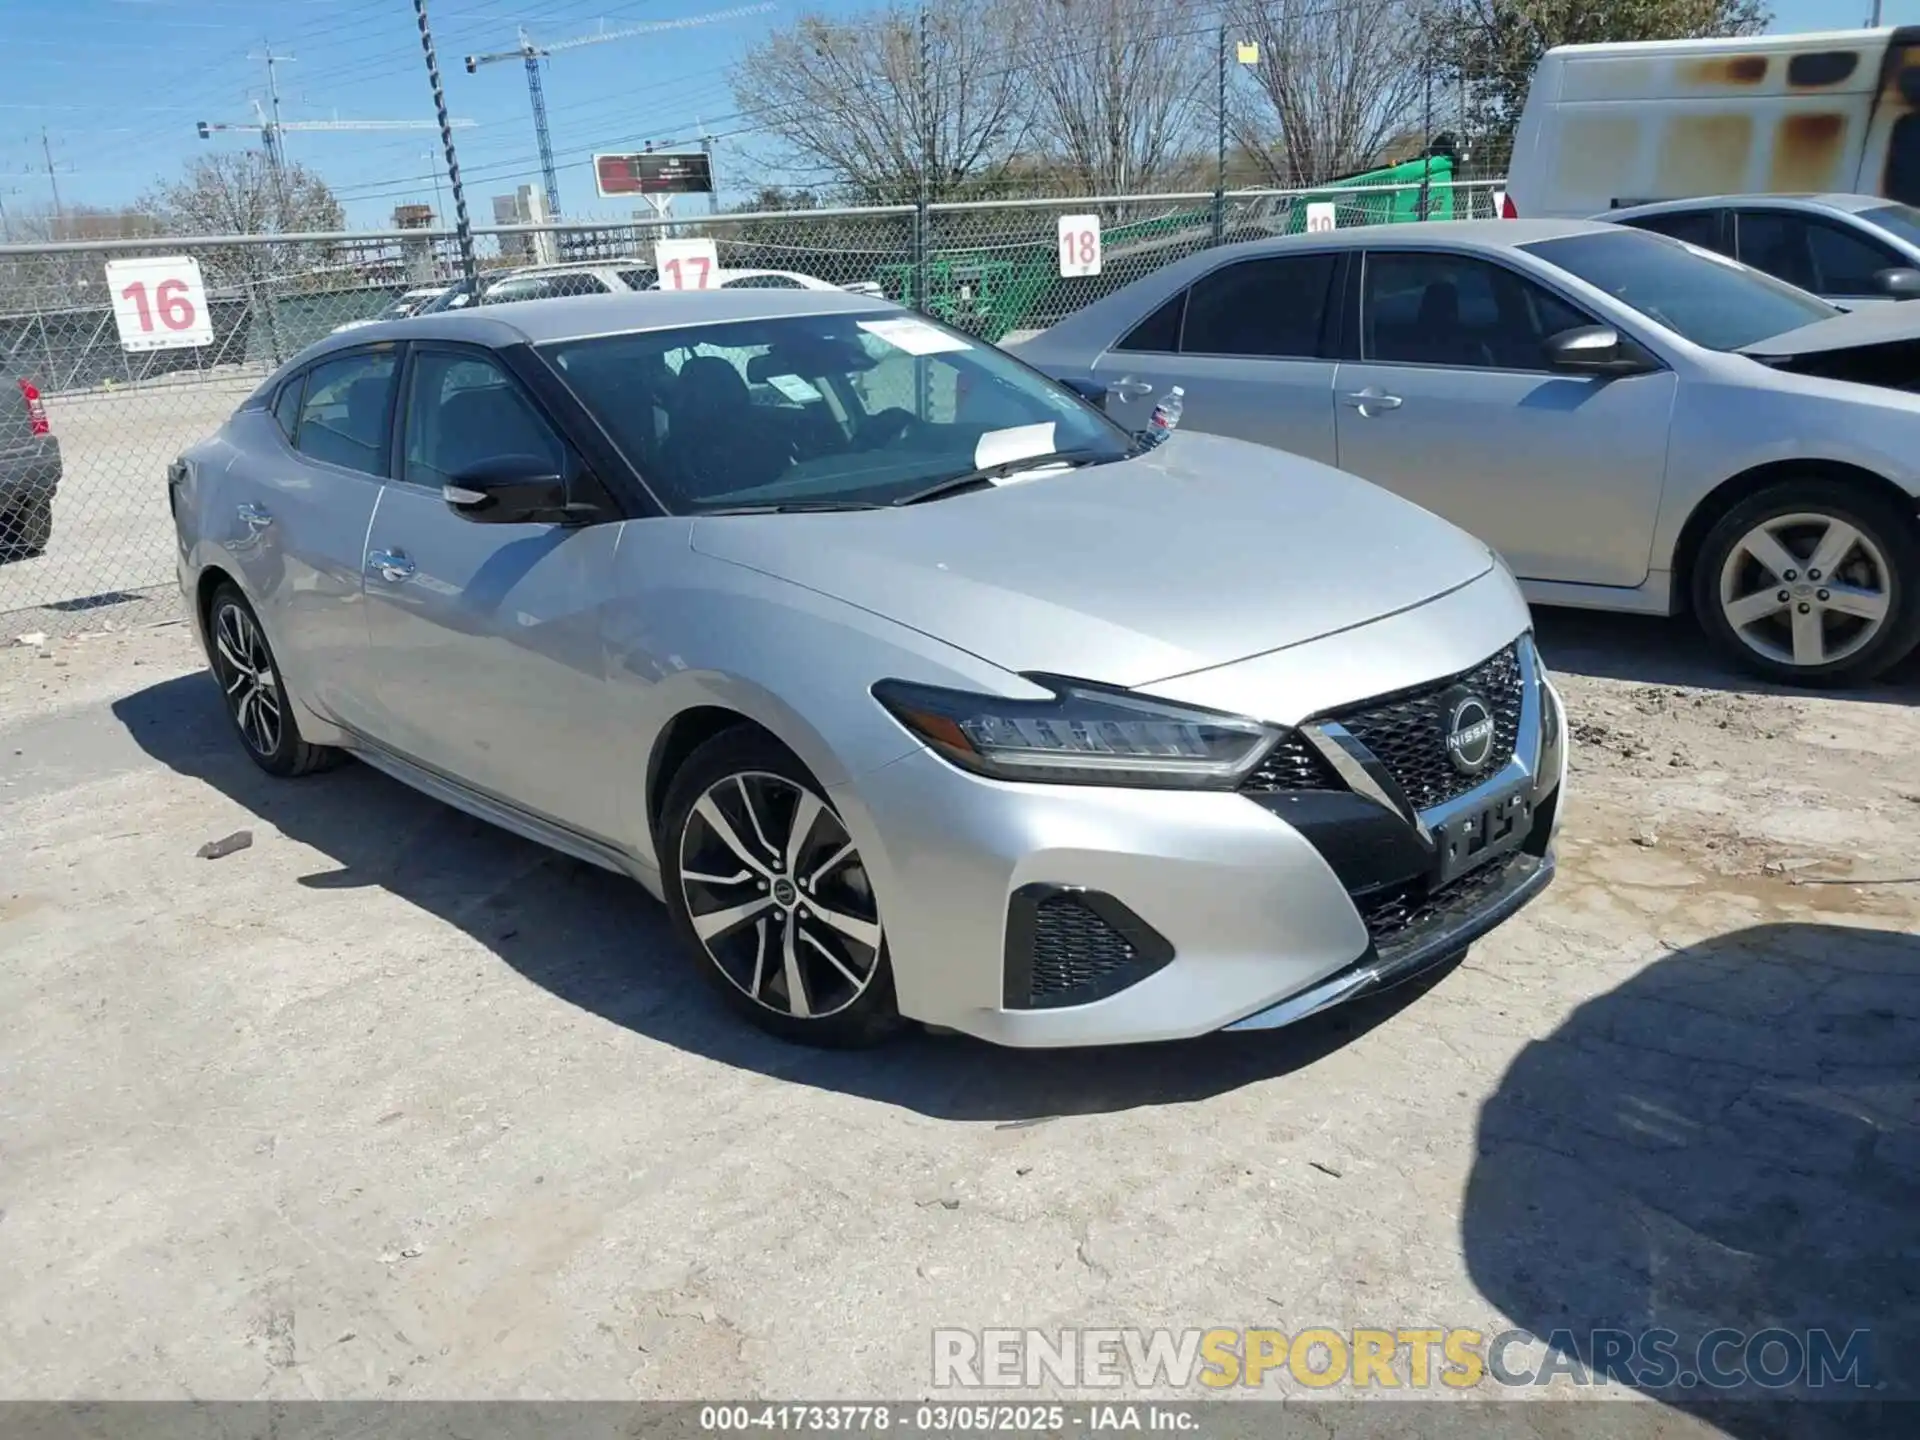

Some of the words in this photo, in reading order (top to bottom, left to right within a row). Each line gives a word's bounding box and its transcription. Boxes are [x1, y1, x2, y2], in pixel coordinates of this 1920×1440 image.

[1063, 230, 1095, 265] 18
[664, 257, 711, 290] 17
[121, 279, 196, 332] 16
[1449, 717, 1494, 749] NISSAN
